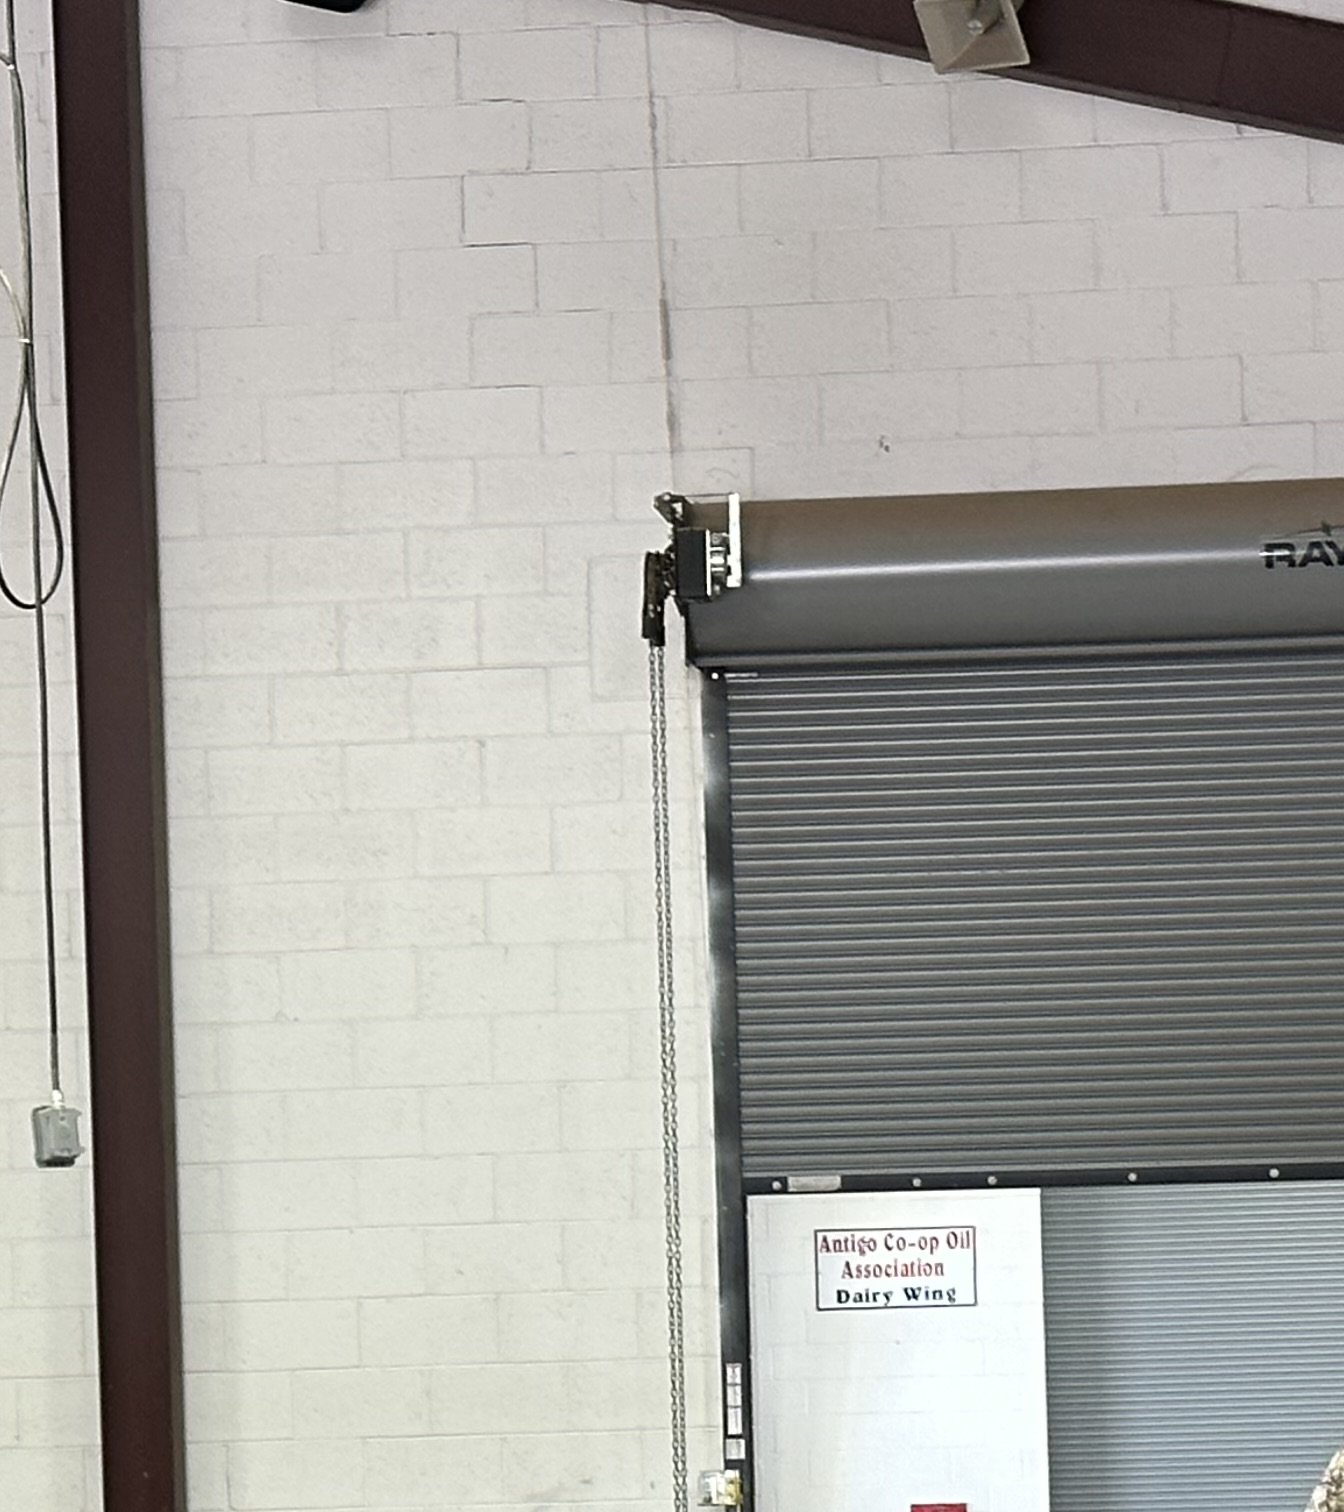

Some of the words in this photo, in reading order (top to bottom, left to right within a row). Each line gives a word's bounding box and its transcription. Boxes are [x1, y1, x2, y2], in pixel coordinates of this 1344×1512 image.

[819, 1233, 877, 1257] Antigo
[883, 1232, 940, 1255] Co-op
[946, 1229, 971, 1250] Oil
[841, 1258, 945, 1280] Association
[836, 1287, 894, 1306] Dairy
[903, 1285, 957, 1304] Wing
